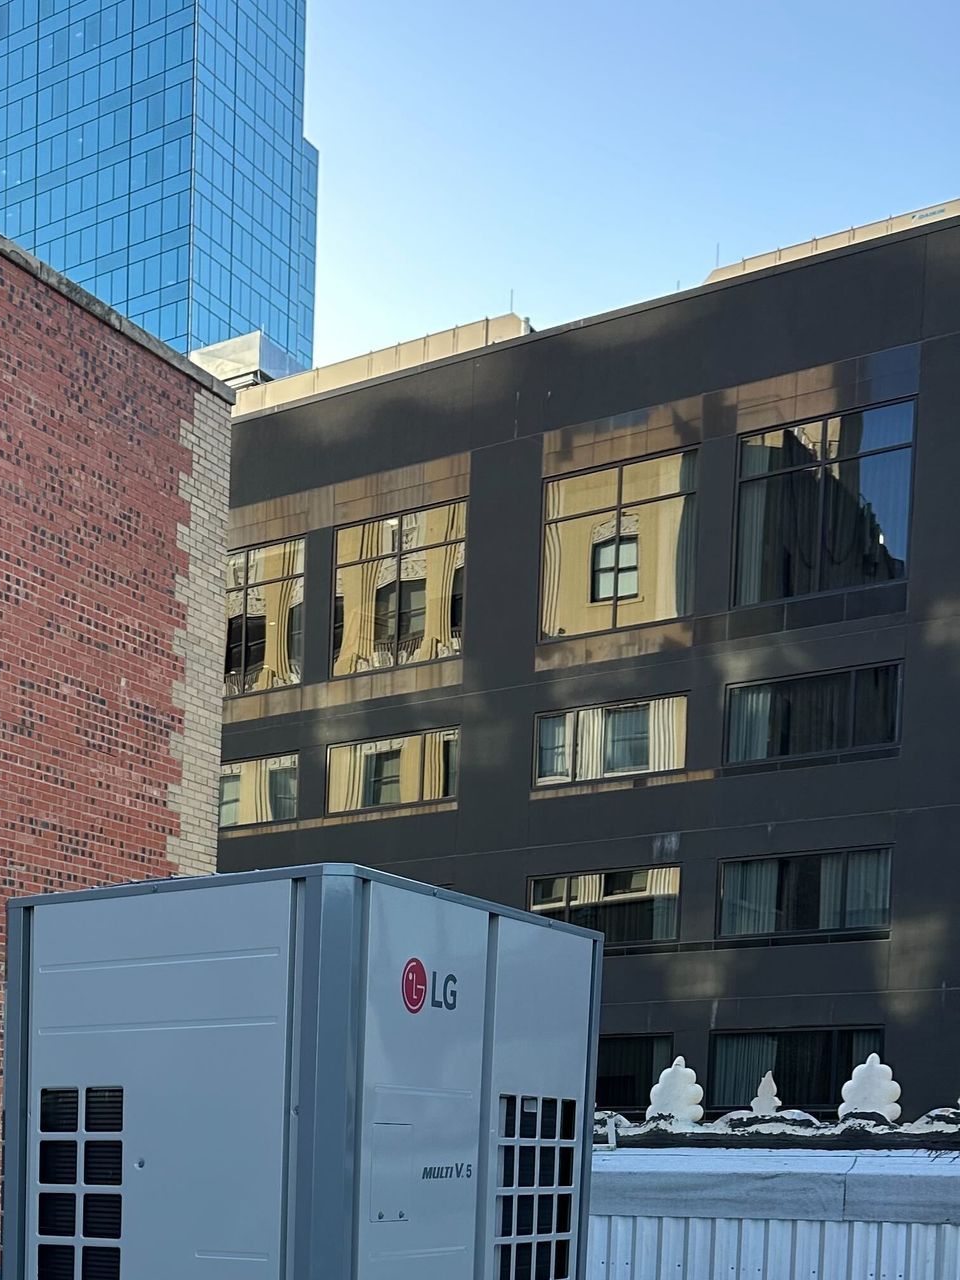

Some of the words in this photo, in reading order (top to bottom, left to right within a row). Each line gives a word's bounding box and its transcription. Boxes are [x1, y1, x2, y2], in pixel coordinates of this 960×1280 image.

[431, 971, 458, 1011] LG
[422, 1166, 454, 1180] MULTI
[466, 1164, 472, 1178] 5
